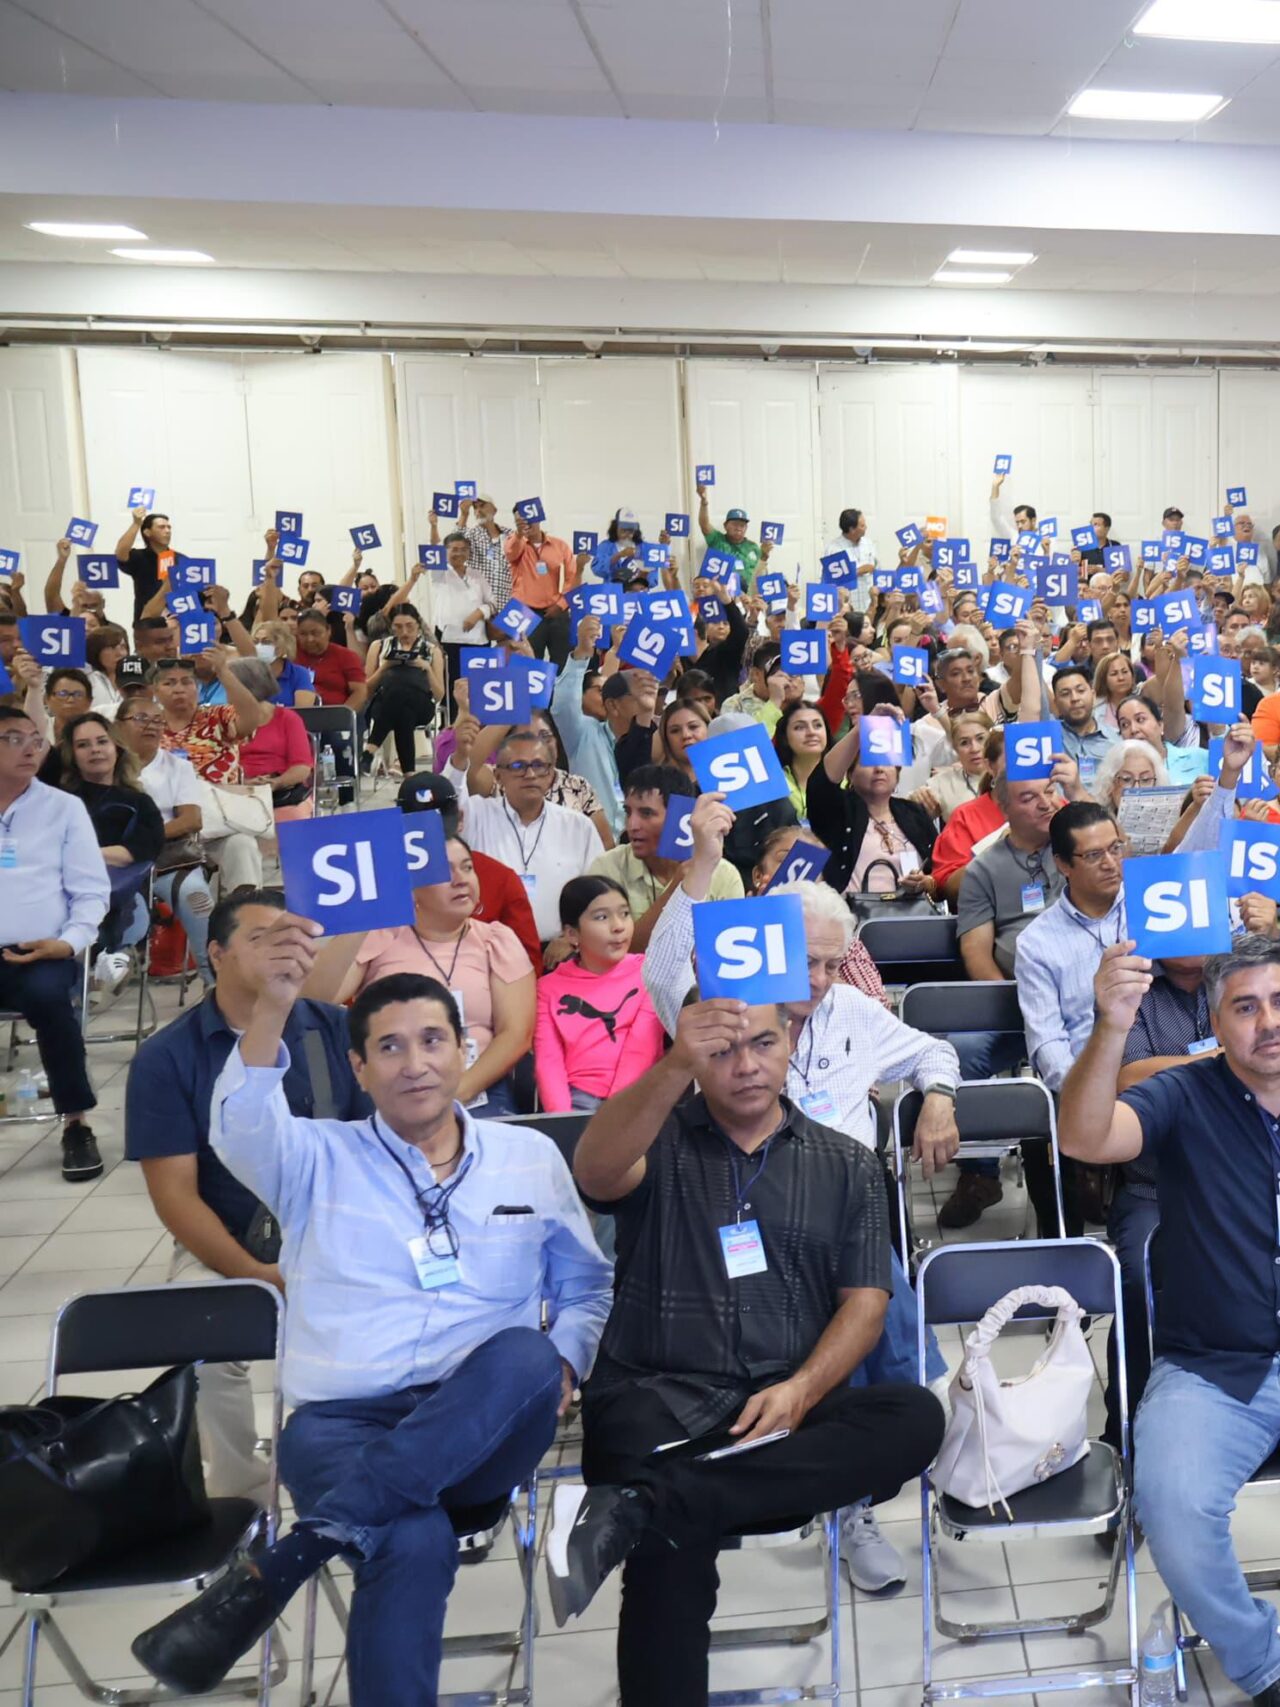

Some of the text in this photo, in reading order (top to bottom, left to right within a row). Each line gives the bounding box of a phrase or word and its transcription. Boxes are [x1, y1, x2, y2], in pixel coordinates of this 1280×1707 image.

[996, 458, 1009, 470] SI
[698, 469, 712, 481] SI
[131, 490, 151, 506] SI
[458, 485, 474, 497] SI
[1230, 492, 1244, 504] SI
[438, 498, 453, 513] SI
[523, 503, 539, 519] SI
[70, 524, 92, 541] SI
[281, 517, 296, 532] SI
[670, 518, 684, 532] SI
[926, 522, 944, 532] NO
[1040, 522, 1055, 536] SI
[1215, 521, 1231, 534] SI
[765, 526, 778, 541] SI
[902, 529, 917, 544] SI
[1018, 534, 1035, 549] SI
[1075, 531, 1094, 547] SI
[281, 543, 304, 559] SI
[578, 536, 592, 551] SI
[993, 543, 1008, 555] SI
[1144, 545, 1159, 557] SI
[425, 550, 441, 565] SI
[648, 549, 666, 563] SI
[938, 547, 953, 566] SI
[1109, 551, 1125, 567] SI
[1210, 553, 1230, 570] SI
[1239, 547, 1255, 560] SI
[87, 561, 109, 581] SI
[186, 566, 210, 583] SI
[706, 557, 729, 577] SI
[828, 559, 850, 579] SI
[876, 574, 893, 588] SI
[901, 573, 919, 588] SI
[957, 569, 972, 584] SI
[762, 579, 782, 596] SI
[1046, 574, 1068, 597] SI
[172, 595, 196, 614] SI
[337, 591, 353, 608] SI
[589, 594, 618, 615] SI
[812, 593, 834, 613] SI
[922, 589, 939, 607] SI
[993, 593, 1024, 618] SI
[649, 599, 683, 621] SI
[703, 600, 720, 618] SI
[1081, 604, 1099, 622] SI
[1136, 608, 1155, 626] SI
[1164, 599, 1193, 623] SI
[502, 608, 532, 633] SI
[41, 627, 70, 655] SI
[185, 623, 208, 644] SI
[1190, 631, 1212, 651] SI
[788, 641, 819, 665] SI
[899, 656, 927, 679] SI
[483, 680, 514, 712] SI
[1202, 673, 1234, 708] SI
[868, 729, 903, 755] SI
[1015, 736, 1057, 767] SI
[705, 747, 768, 797] SI
[674, 813, 695, 847] S
[313, 841, 377, 905] SI
[785, 857, 815, 882] SI
[1144, 879, 1209, 931] SI
[716, 924, 786, 979] SI
